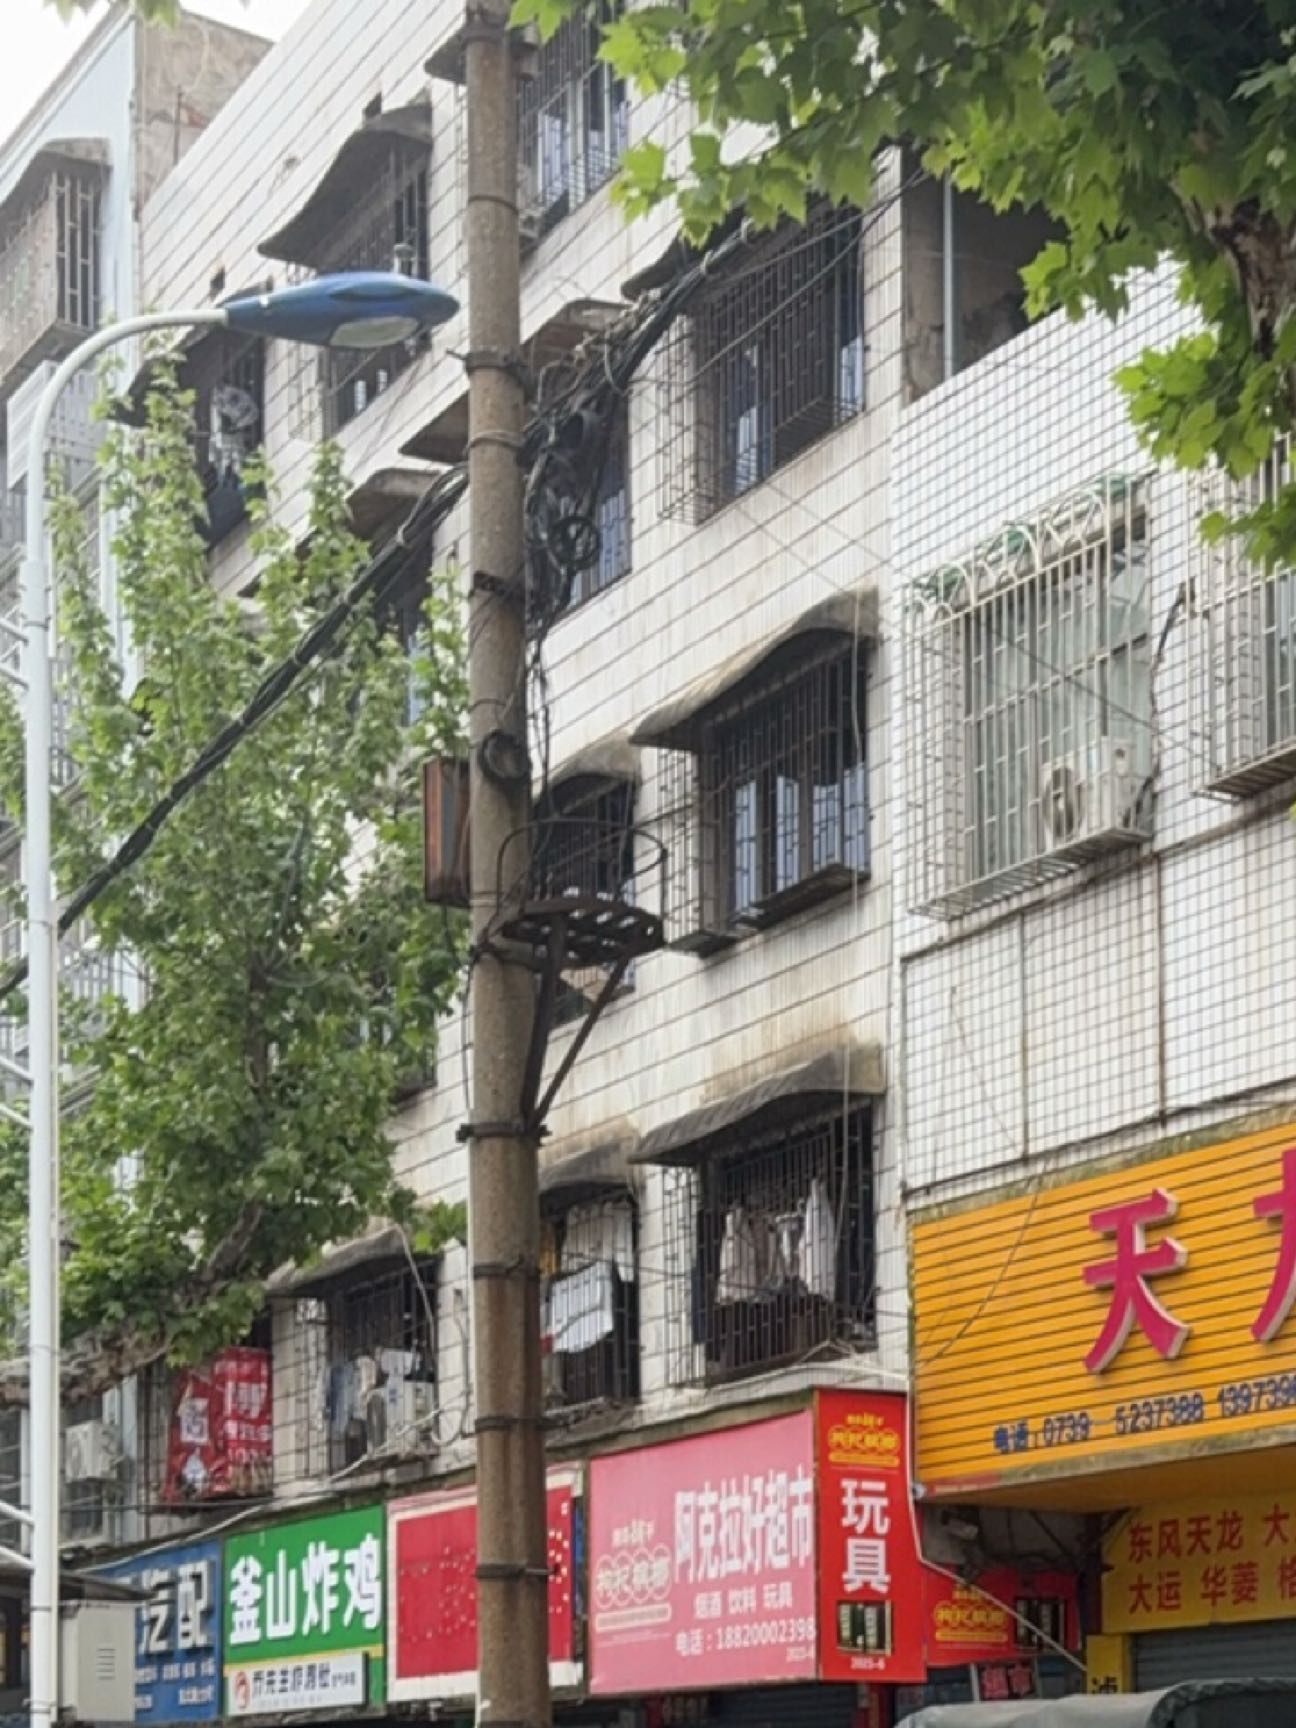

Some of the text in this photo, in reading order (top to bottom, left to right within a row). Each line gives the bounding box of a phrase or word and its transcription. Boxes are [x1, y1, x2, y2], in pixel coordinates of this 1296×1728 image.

[839, 1478, 891, 1594] 玩具
[1127, 1508, 1245, 1564] 东风天龙
[229, 1533, 382, 1645] 釜山炸鸡
[1127, 1569, 1183, 1615] 大运
[1201, 1558, 1260, 1606] 华菱
